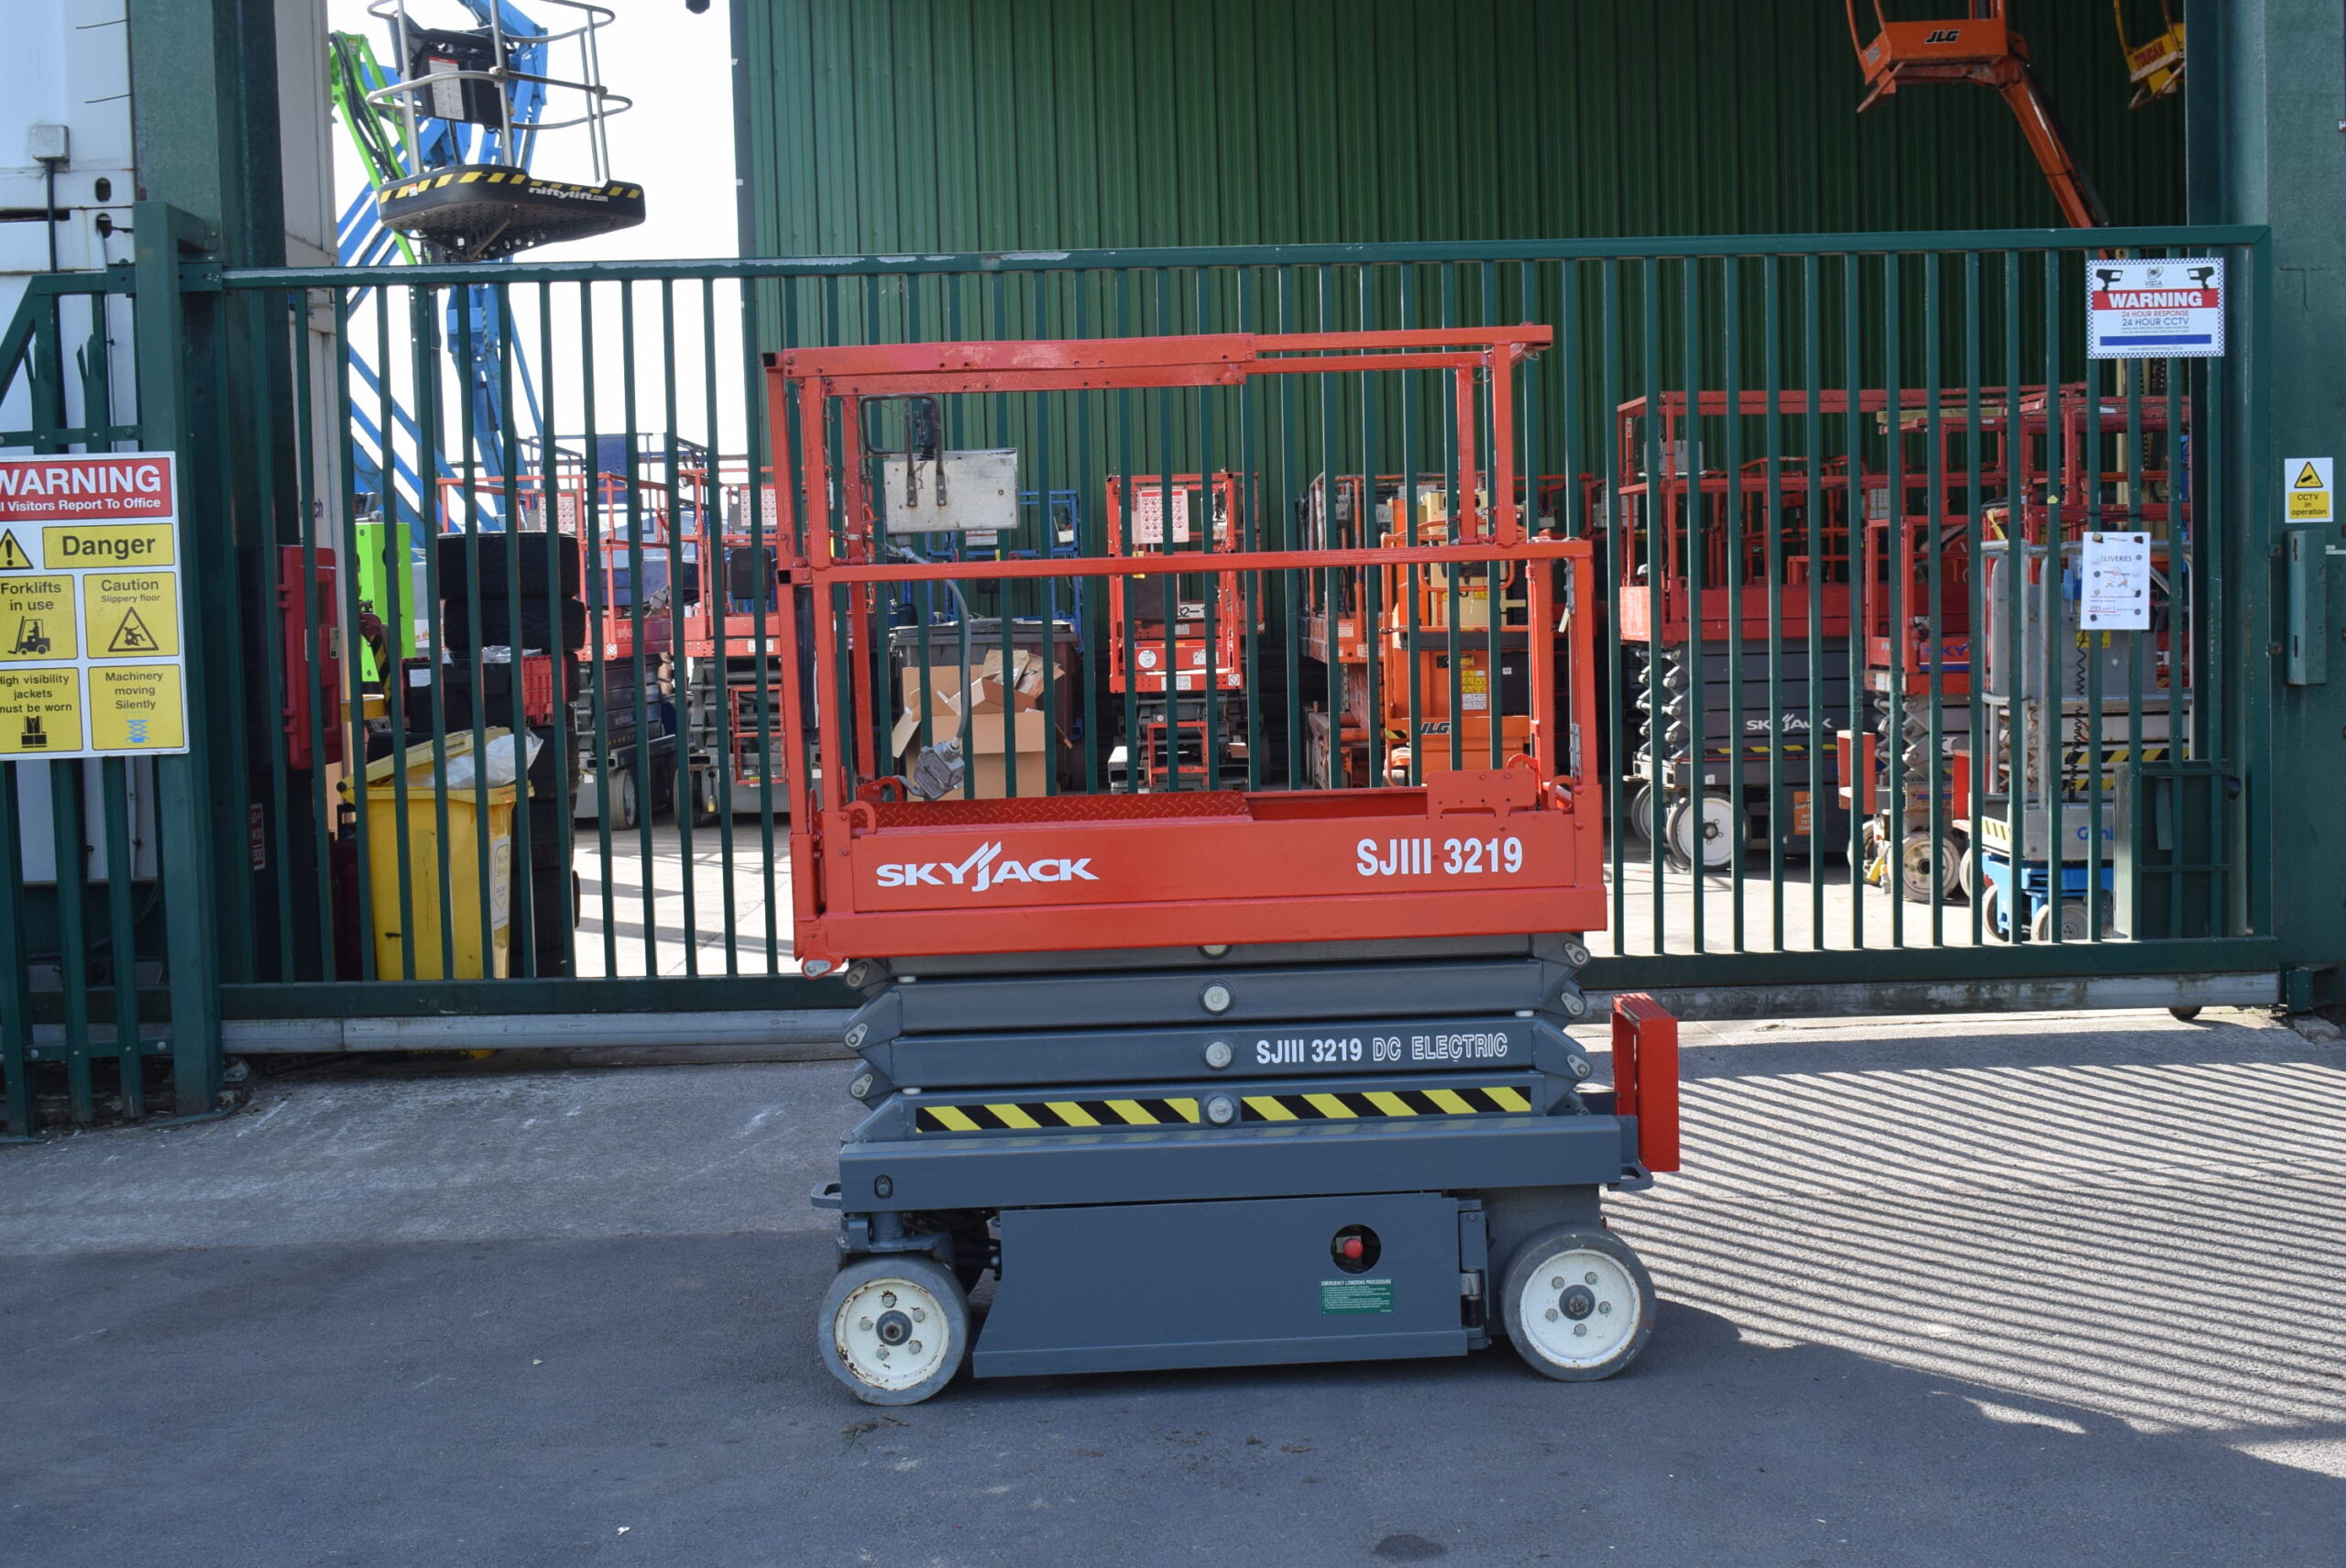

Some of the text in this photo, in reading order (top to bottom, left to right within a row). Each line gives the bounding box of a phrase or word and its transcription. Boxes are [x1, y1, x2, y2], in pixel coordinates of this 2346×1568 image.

[1924, 29, 1959, 44] JLG
[2133, 39, 2166, 71] TOUCAN
[528, 187, 608, 203] niftylift.com
[2108, 291, 2202, 309] WARNING
[2135, 318, 2161, 326] HOUR
[2164, 317, 2189, 325] CCTV
[7, 500, 55, 512] Visitors
[59, 499, 103, 512] Report
[104, 498, 120, 510] To
[124, 497, 160, 509] Office
[2291, 508, 2327, 516] operation
[61, 535, 156, 560] Danger
[2099, 554, 2132, 563] ELIVERIES
[0, 582, 61, 595] Forklifts
[101, 579, 159, 592] Caution
[9, 599, 54, 611] in use
[101, 594, 160, 604] Slippery floor
[24, 674, 70, 685] visibility
[105, 672, 163, 683] Machinery
[14, 689, 53, 701] jackets
[115, 685, 156, 696] moving
[27, 704, 40, 713] be
[45, 704, 72, 712] worn
[115, 699, 156, 710] Silently
[1419, 721, 1451, 735] JLG
[1356, 836, 1523, 877] SJIII 3219
[875, 840, 1100, 893] SKYJACK
[1256, 1032, 1507, 1064] SJIII 3219 DC ELECTRIC
